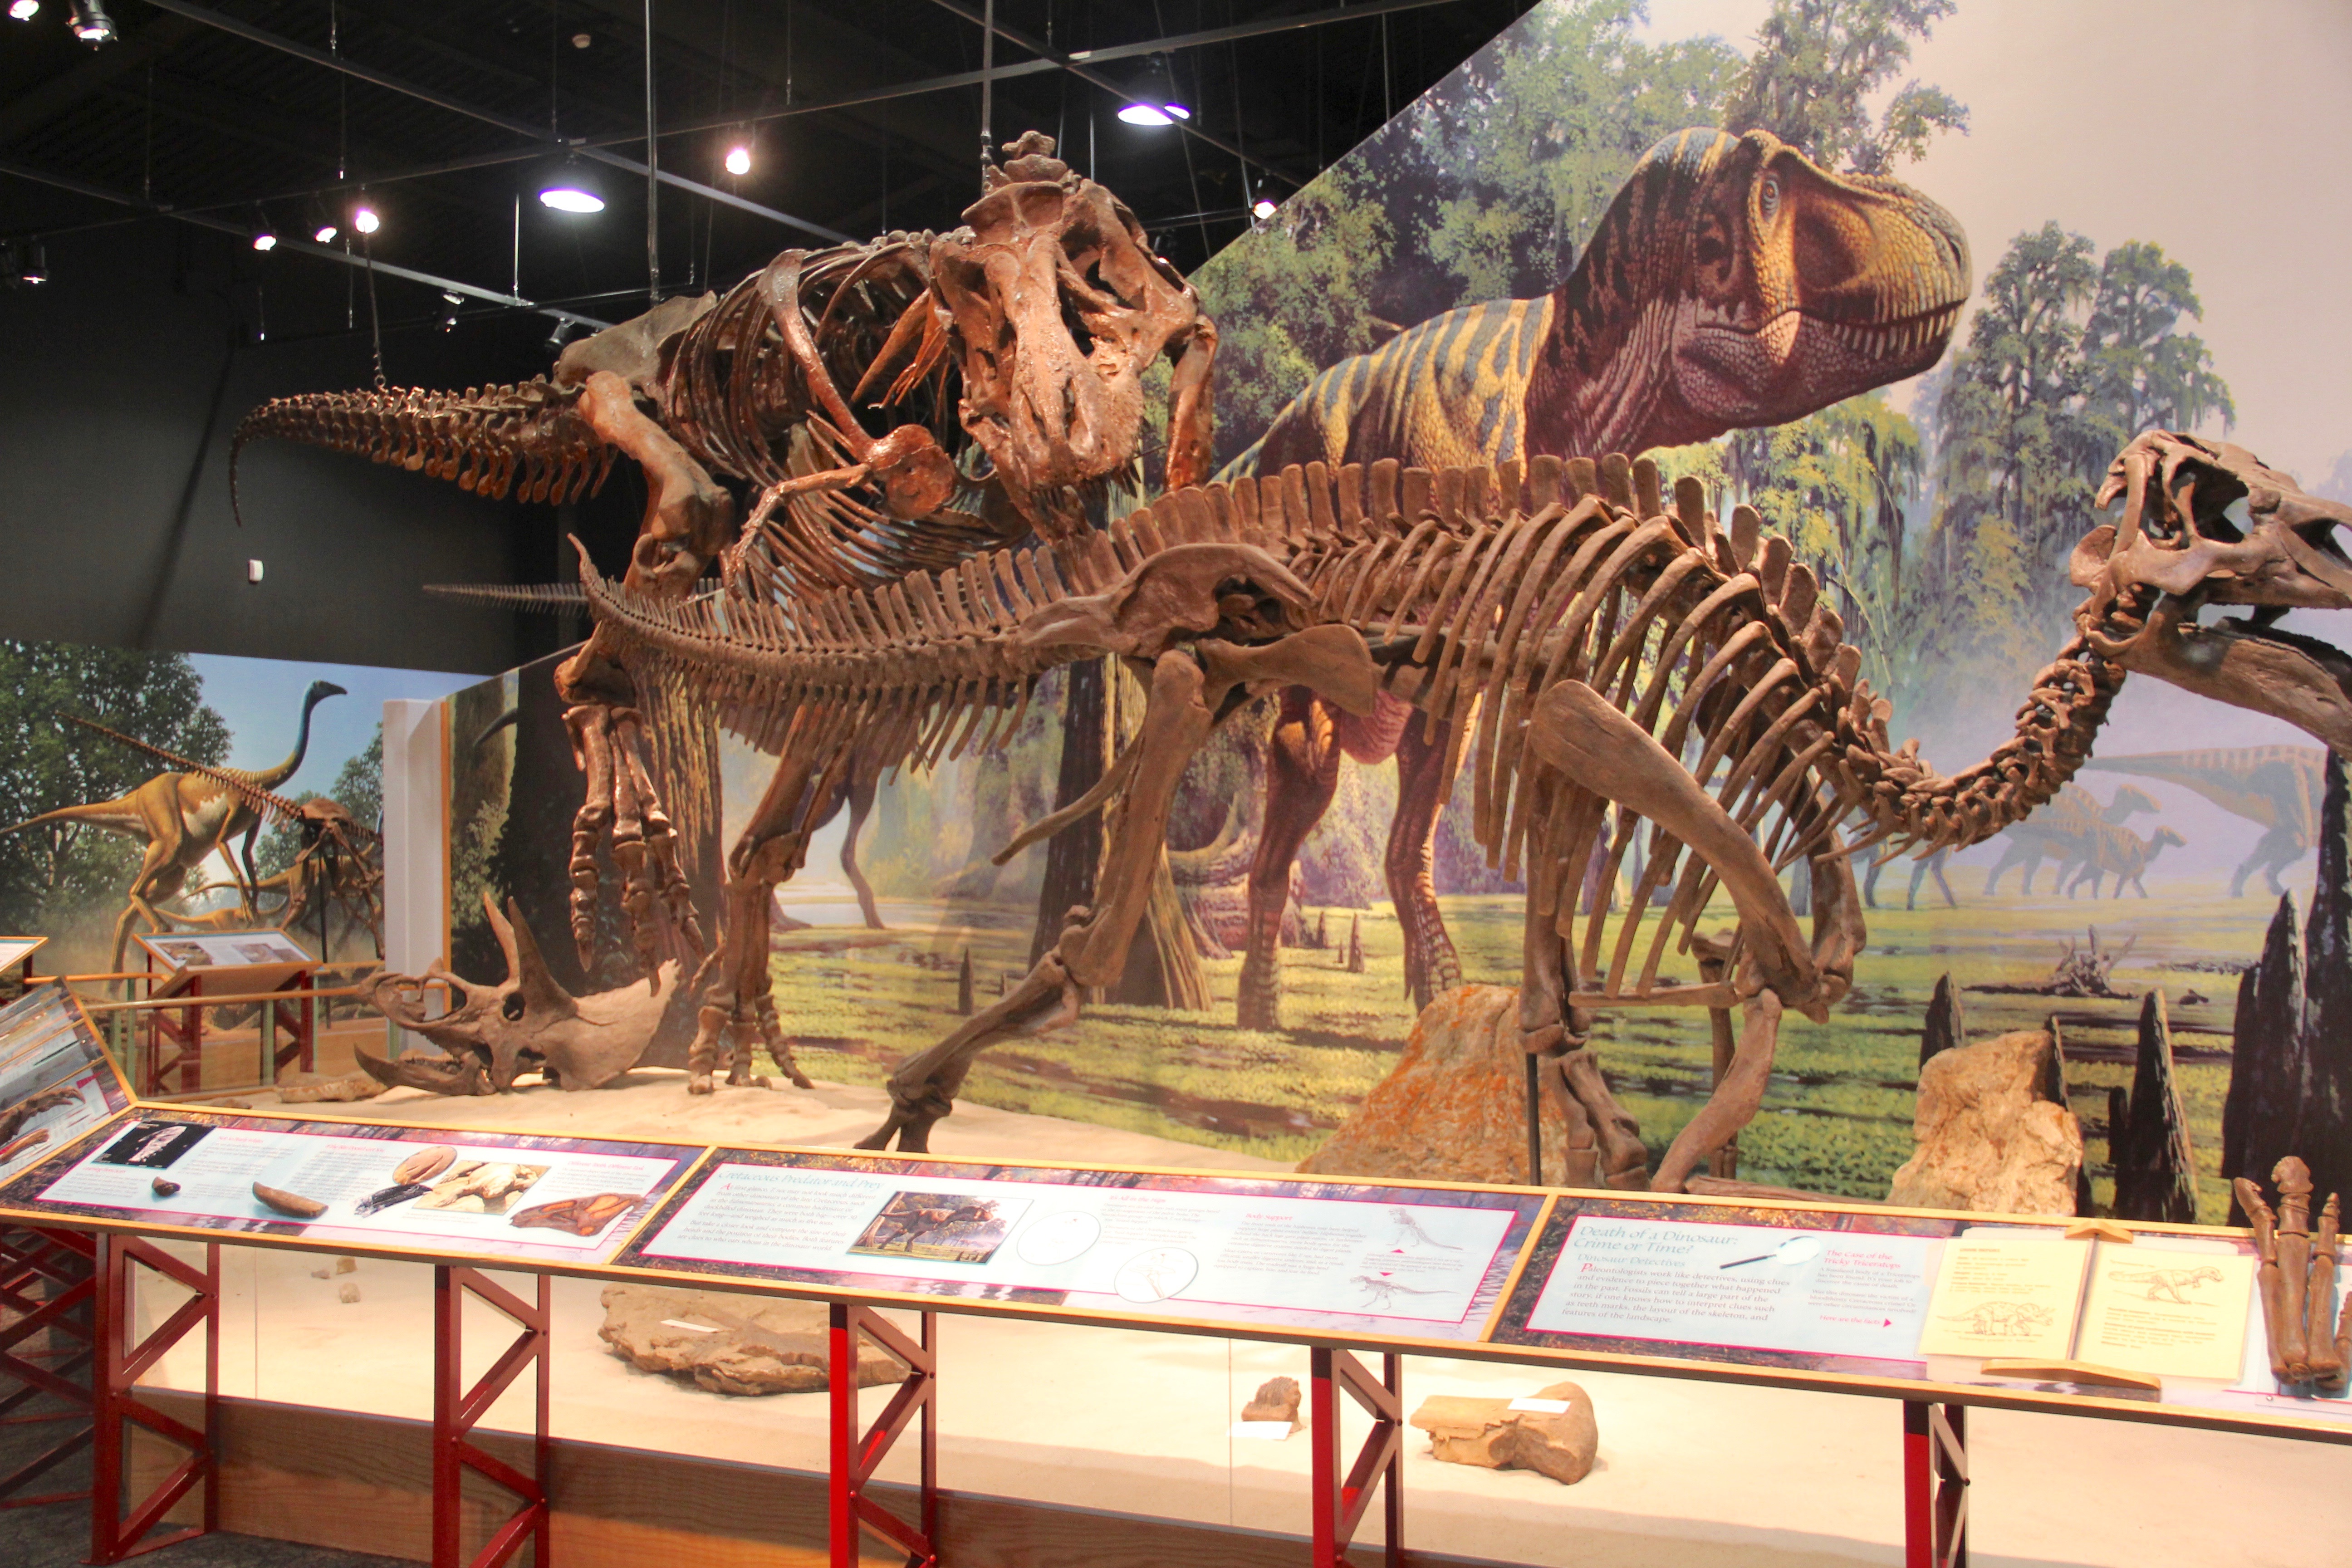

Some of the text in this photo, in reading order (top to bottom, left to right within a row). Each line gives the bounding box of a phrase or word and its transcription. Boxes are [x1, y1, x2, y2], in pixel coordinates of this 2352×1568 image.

[718, 1171, 884, 1191] Cretaceous Predator and Prey
[1580, 1226, 1625, 1238] Death
[1629, 1229, 1650, 1239] of
[1662, 1231, 1738, 1245] Dinosaur:
[1573, 1238, 1621, 1249] Crime
[1647, 1241, 1694, 1254] Time?
[1577, 1254, 1685, 1267] Dinosaur Detectives
[1824, 1257, 1901, 1269] Tricky Triceratops
[1580, 1263, 1647, 1276] Paleontologists
[1692, 1273, 1737, 1282] detectives,
[1740, 1277, 1765, 1285] using
[1672, 1281, 1709, 1289] together
[1735, 1285, 1780, 1294] happened
[1695, 1291, 1718, 1299] large
[1686, 1299, 1726, 1308] interpret
[1562, 1308, 1595, 1317] features
[1626, 1313, 1671, 1323] landscape.
[1648, 1306, 1677, 1314] layout
[1707, 1311, 1747, 1320] skeleton,
